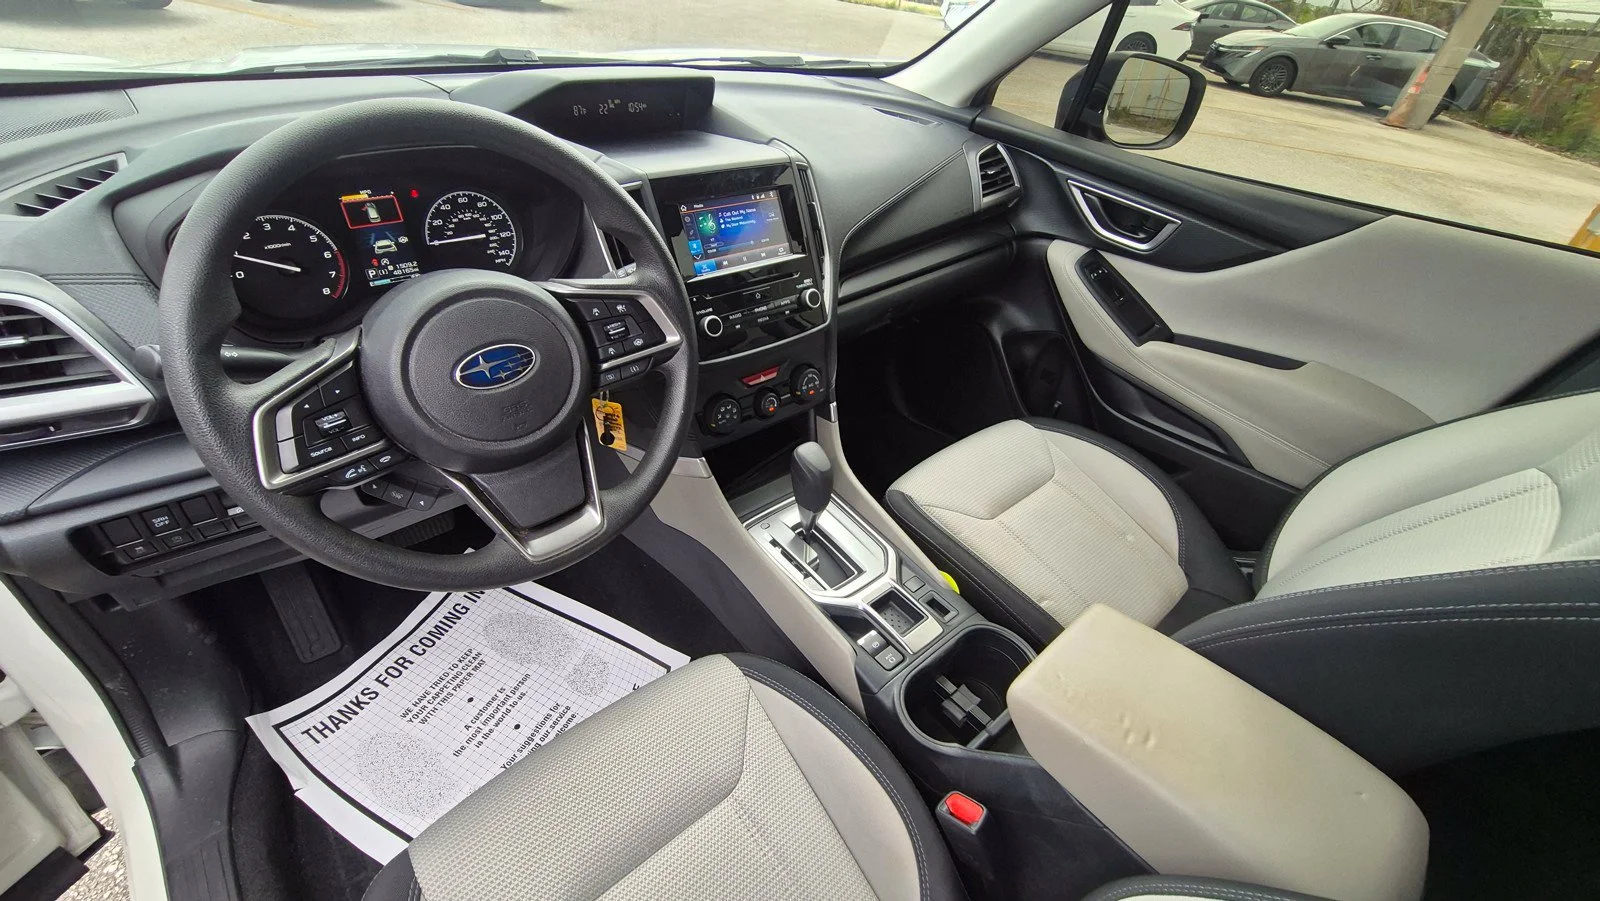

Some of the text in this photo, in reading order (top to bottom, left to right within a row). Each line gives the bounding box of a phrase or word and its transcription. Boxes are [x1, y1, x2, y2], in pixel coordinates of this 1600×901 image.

[243, 232, 251, 240] 2
[263, 223, 271, 231] 3
[309, 235, 318, 243] 5
[323, 251, 332, 259] 6
[235, 271, 245, 279] 0
[368, 270, 376, 279] P
[322, 287, 331, 295] 8
[154, 519, 170, 528] OFF
[301, 687, 380, 745] THANKS
[374, 656, 414, 688] FOR
[409, 602, 471, 656] COMING
[400, 648, 473, 719] WE HAVE TRIED TO KEEP
[407, 651, 482, 724] YOUR CARPETING CLEAN
[418, 659, 486, 725] WITH THIS PAPER MAT
[453, 673, 531, 757] the most important person
[471, 693, 499, 724] customer
[482, 728, 495, 740] the
[493, 708, 511, 727] world
[509, 700, 518, 708] to
[517, 691, 528, 701] us.
[500, 703, 561, 770] Your suggestions for
[539, 729, 551, 743] our
[550, 705, 571, 730] service
[554, 712, 579, 739] elcome.
